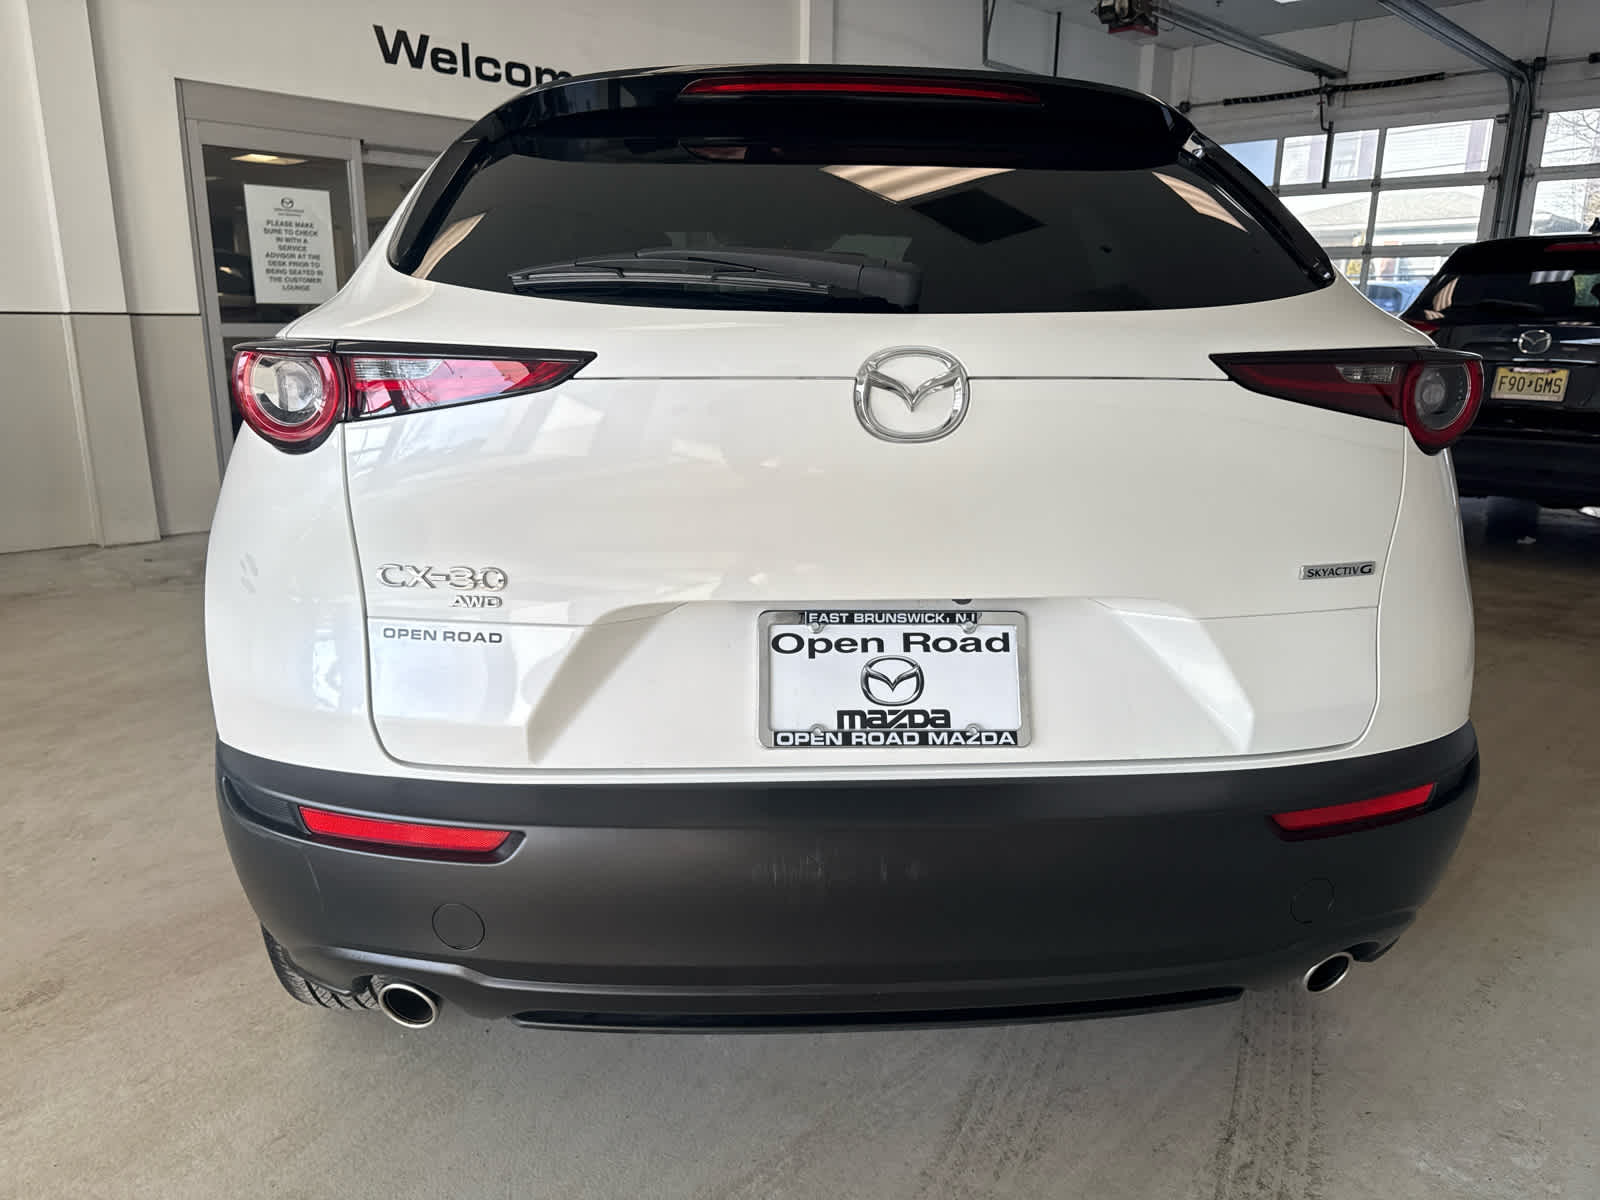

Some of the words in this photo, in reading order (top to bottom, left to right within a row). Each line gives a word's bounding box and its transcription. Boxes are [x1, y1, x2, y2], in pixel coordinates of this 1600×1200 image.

[295, 229, 318, 237] CHECK
[265, 251, 296, 259] ADVISOR
[310, 261, 321, 269] TO
[283, 276, 322, 284] CUSTOMER
[377, 563, 508, 592] CX-30
[449, 595, 503, 608] AWD
[808, 612, 849, 624] EAST
[383, 628, 437, 641] OPEN
[443, 630, 503, 644] ROAD
[771, 632, 885, 659] Open
[902, 632, 1010, 653] Road
[776, 732, 843, 746] OPEN
[851, 732, 920, 746] ROAD
[928, 732, 1016, 745] MAZDA
